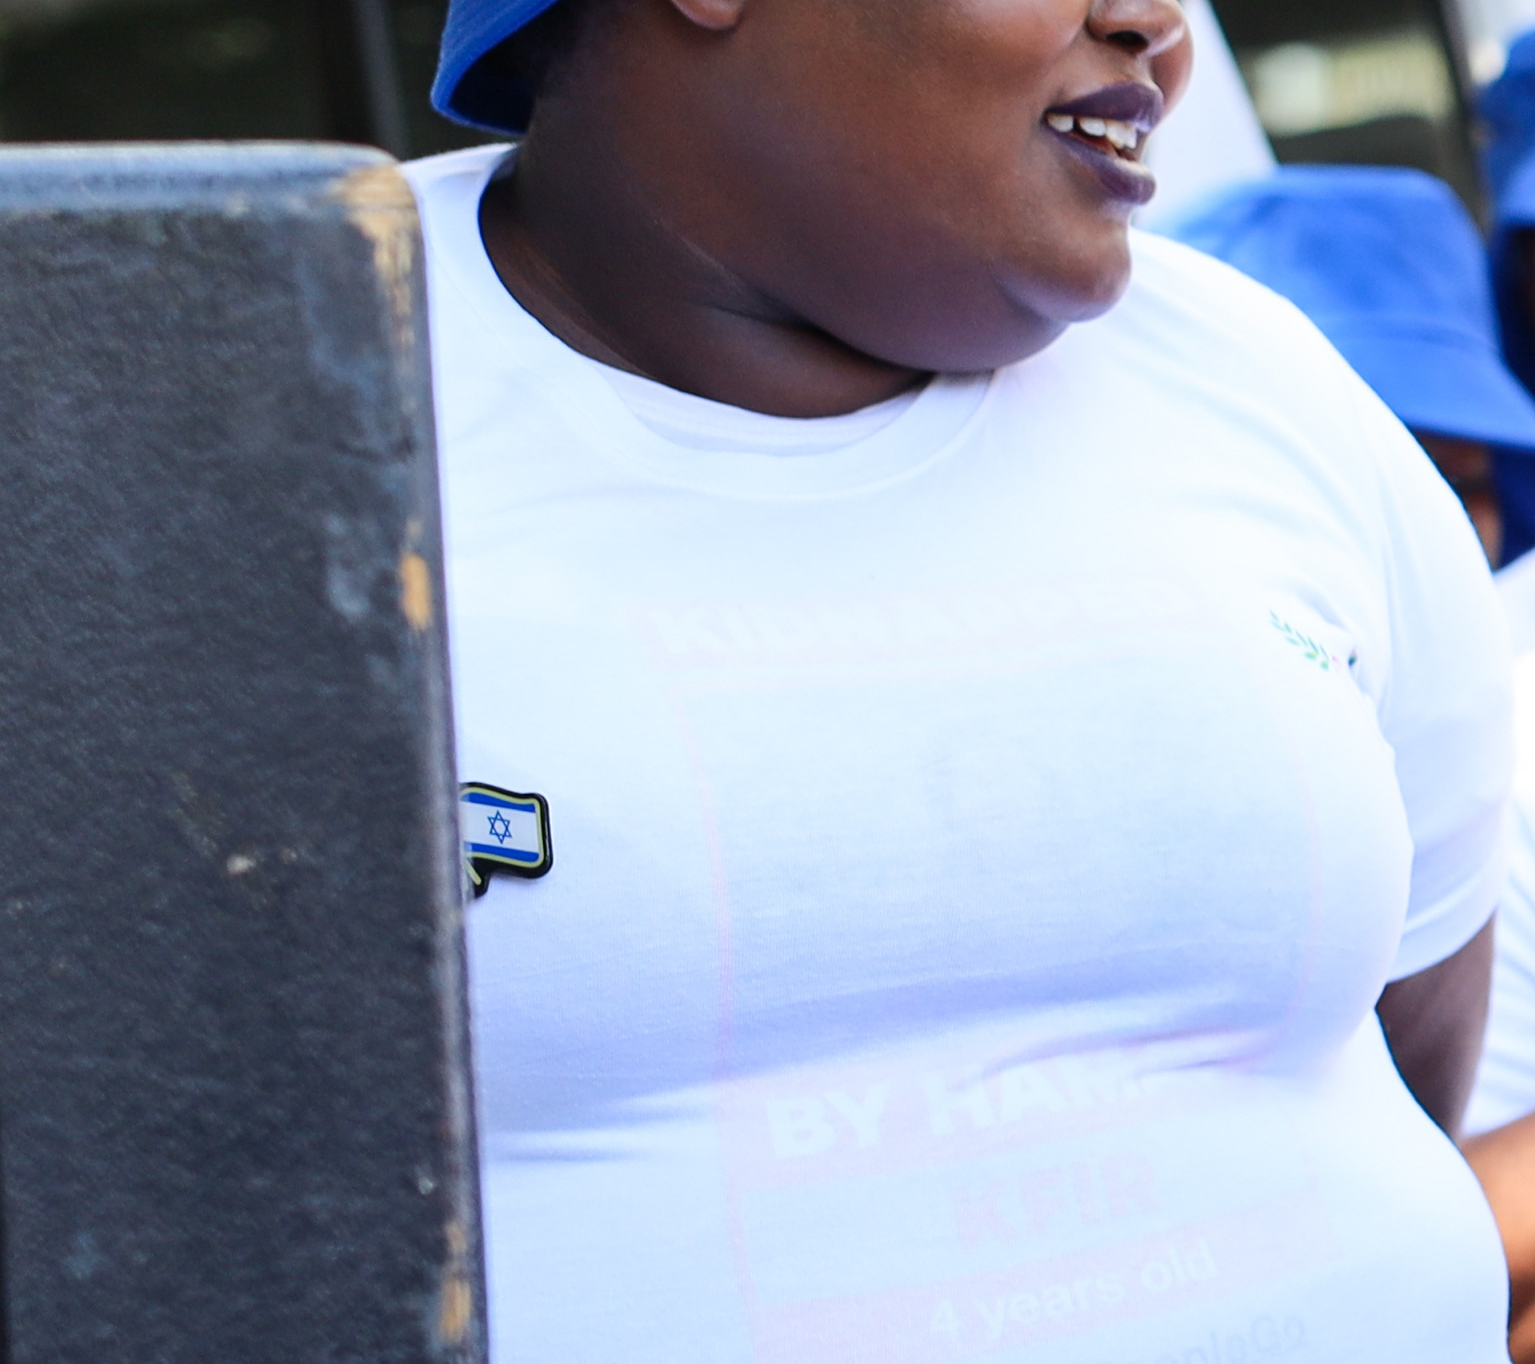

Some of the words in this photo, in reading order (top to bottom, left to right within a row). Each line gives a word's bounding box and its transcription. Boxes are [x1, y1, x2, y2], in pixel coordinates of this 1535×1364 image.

[766, 1082, 892, 1161] BY
[922, 1047, 1225, 1135] HAM
[951, 1151, 1162, 1252] KFIR
[930, 1299, 964, 1340] 4
[978, 1269, 1127, 1342] years
[1141, 1237, 1220, 1294] old
